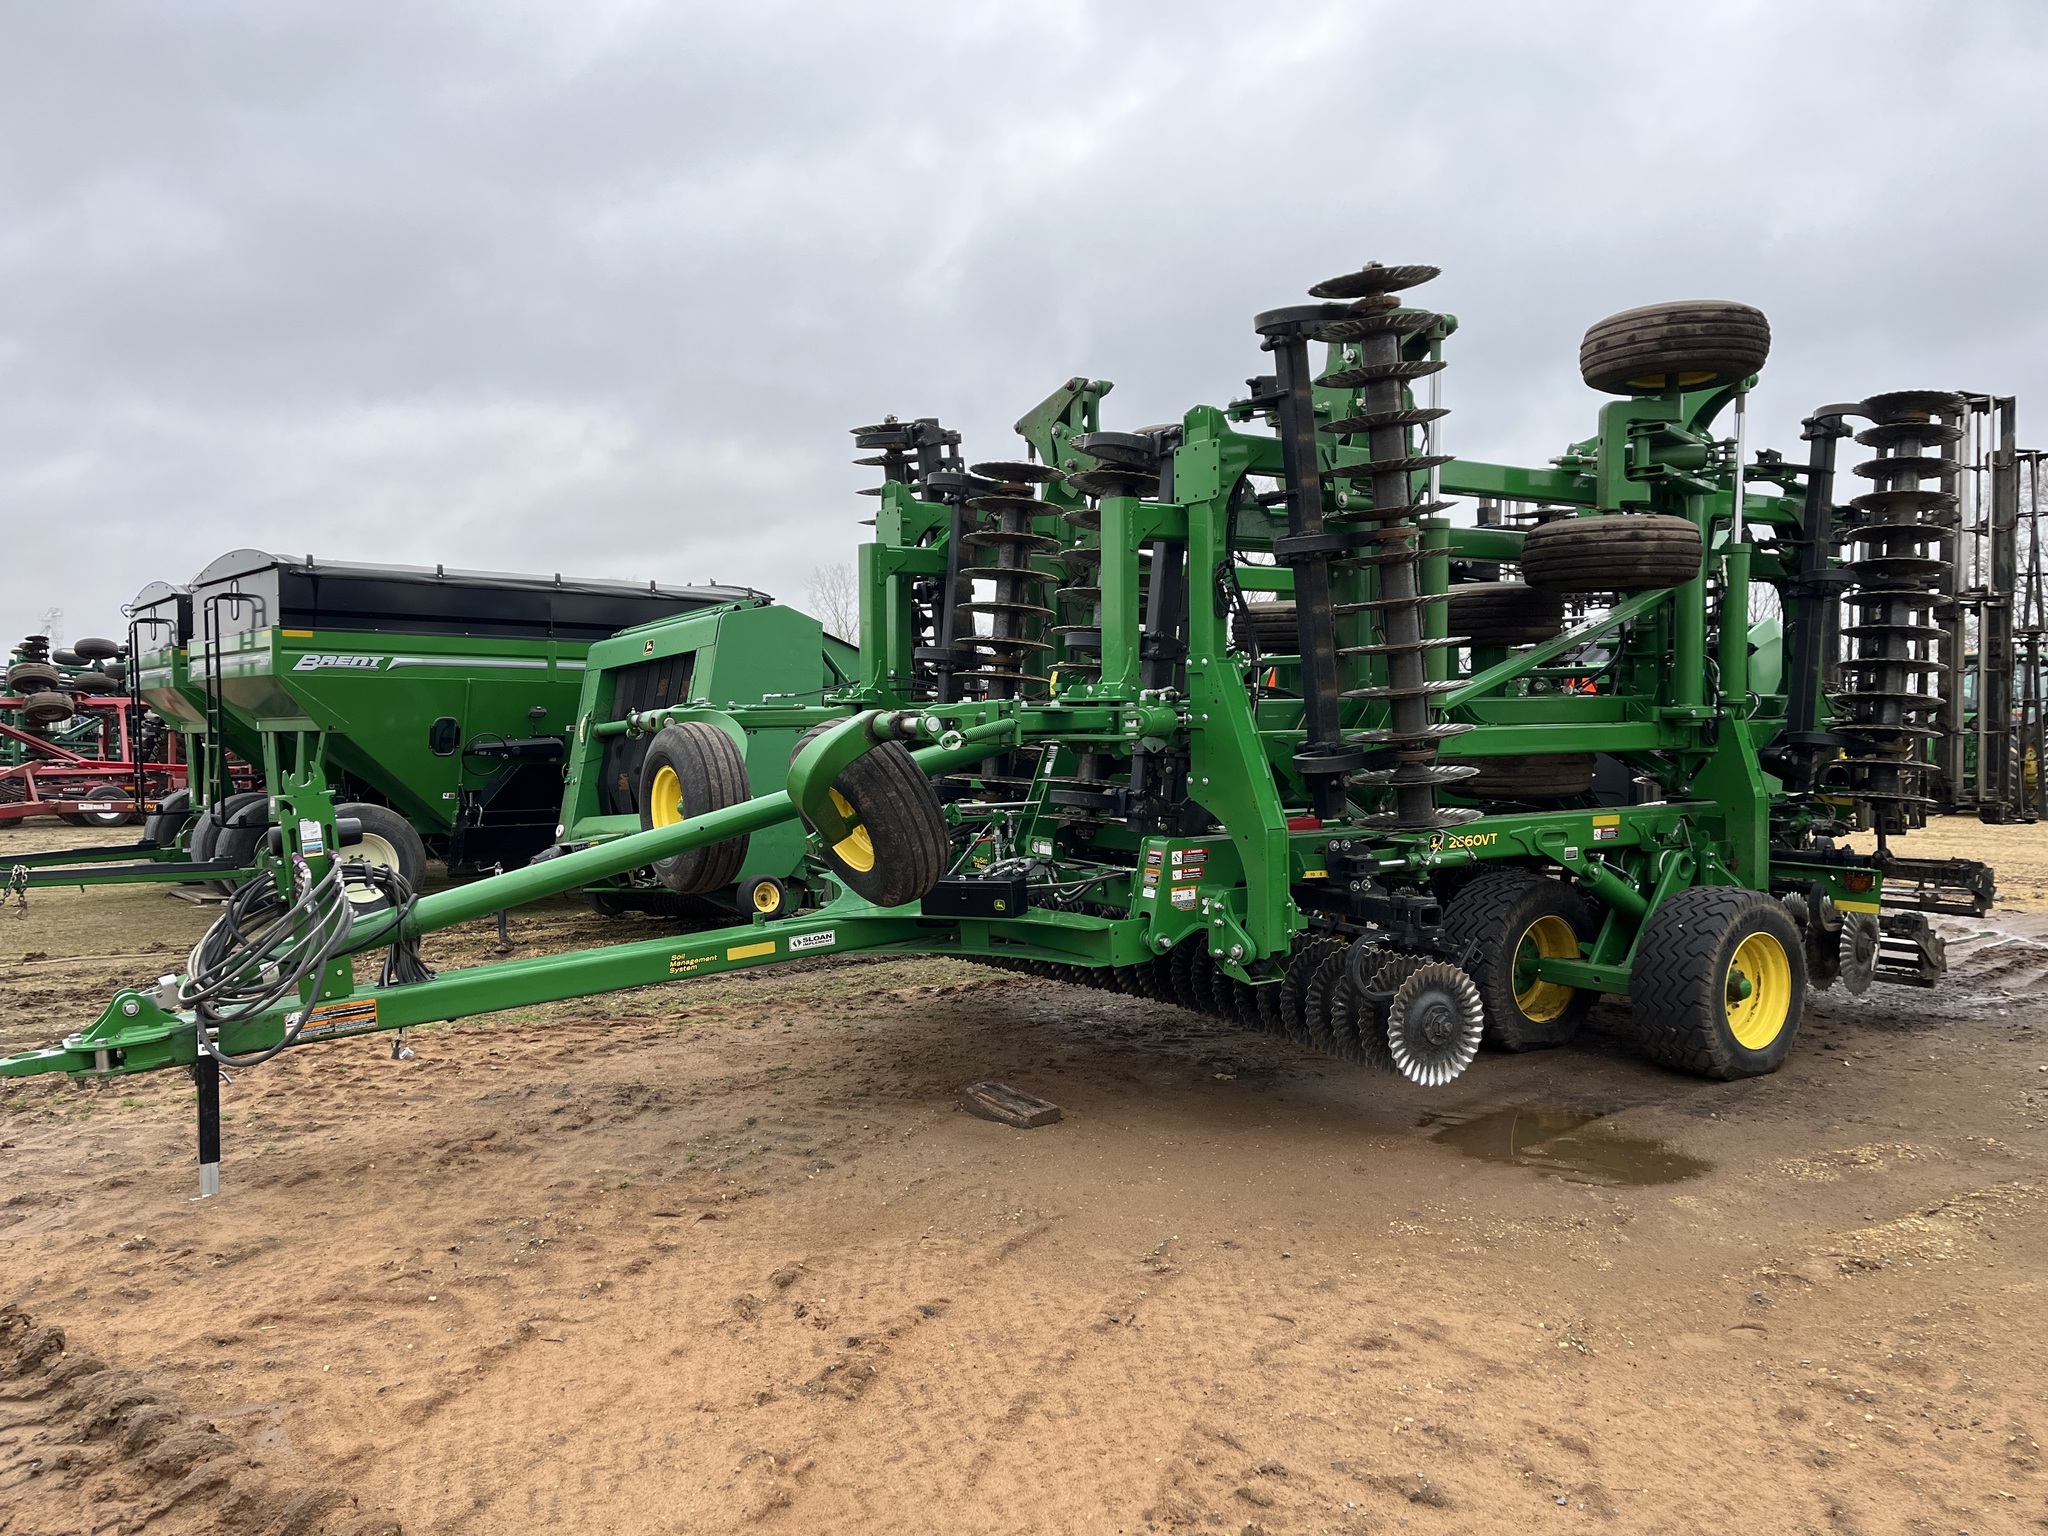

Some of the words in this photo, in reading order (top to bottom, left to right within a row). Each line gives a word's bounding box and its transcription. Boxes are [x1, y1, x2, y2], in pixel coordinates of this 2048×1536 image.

[292, 654, 385, 671] BRENT
[803, 933, 832, 943] SLOAN
[669, 954, 718, 967] Management
[671, 953, 686, 961] Soil
[669, 964, 698, 974] System
